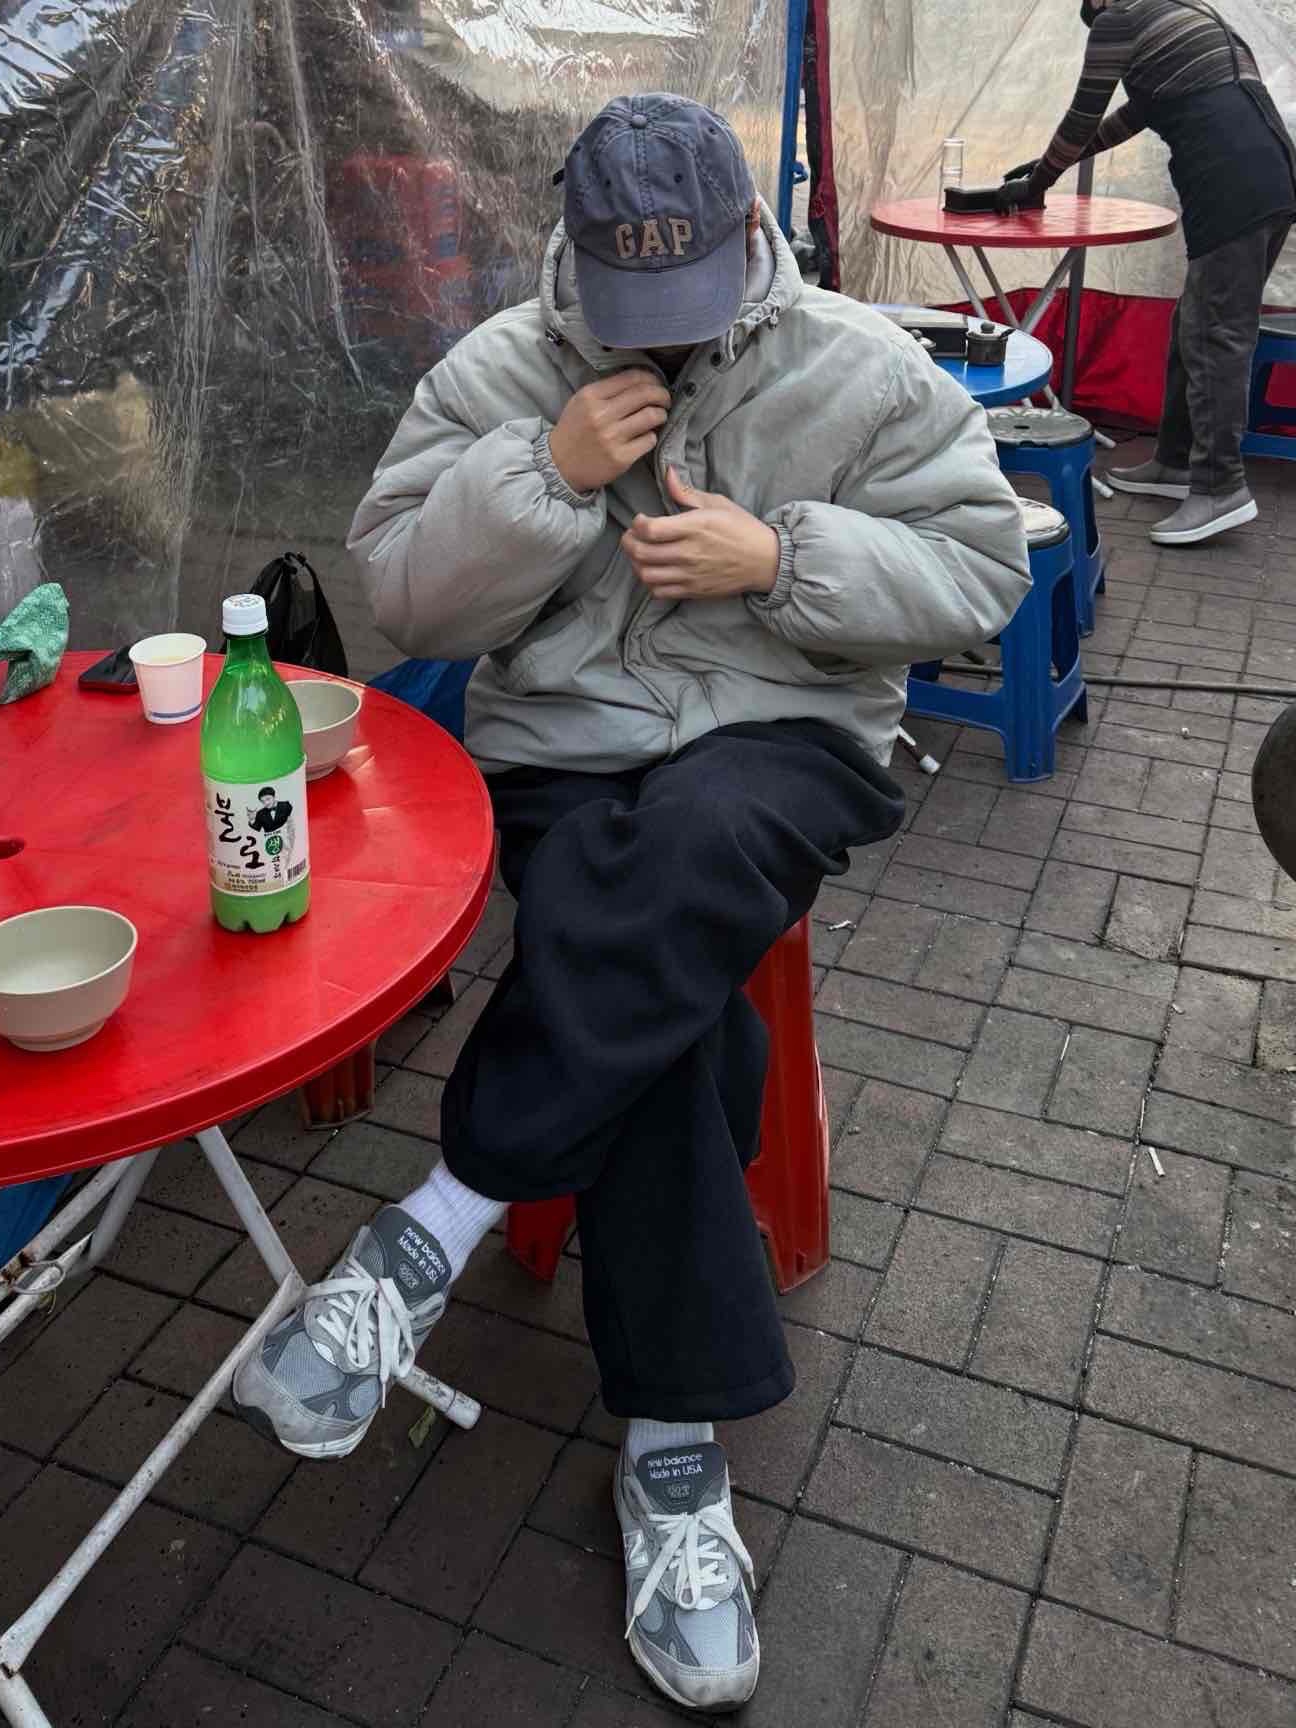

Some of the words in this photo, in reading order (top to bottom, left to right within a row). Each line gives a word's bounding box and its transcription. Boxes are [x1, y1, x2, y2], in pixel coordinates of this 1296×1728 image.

[615, 217, 693, 259] GAP
[403, 1227, 423, 1246] new
[398, 1235, 419, 1259] Made
[647, 1458, 663, 1468] new
[664, 1454, 703, 1466] balance
[648, 1468, 670, 1479] Made
[672, 1467, 681, 1477] in
[682, 1463, 703, 1475] USA
